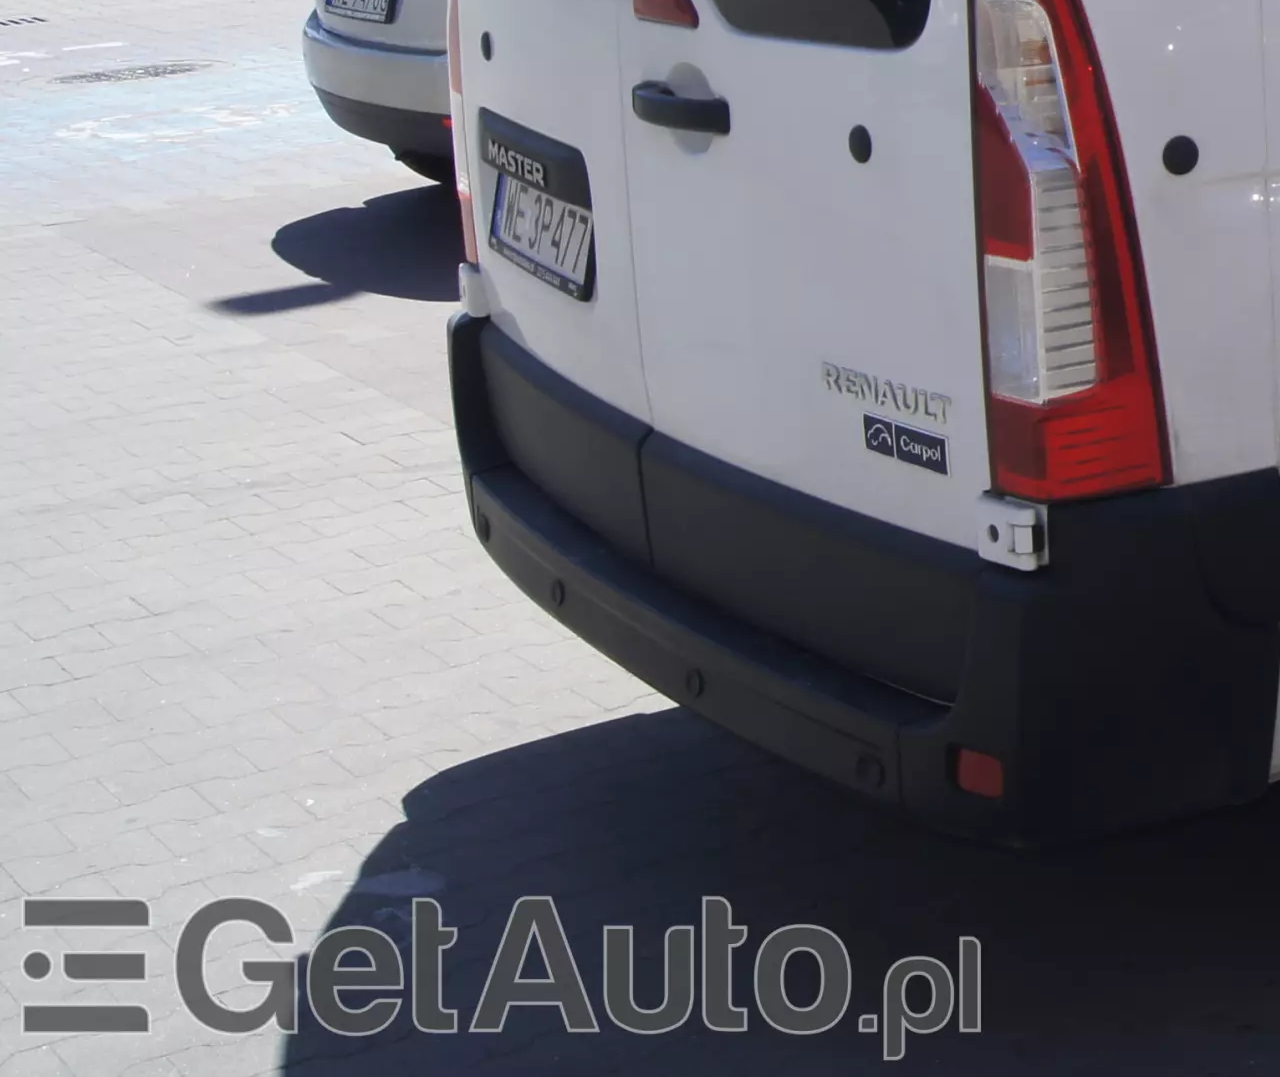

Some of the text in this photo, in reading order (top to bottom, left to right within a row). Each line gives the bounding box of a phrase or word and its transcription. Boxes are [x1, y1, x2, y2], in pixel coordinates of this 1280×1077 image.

[487, 138, 545, 187] MASTER
[503, 175, 529, 243] WE
[528, 193, 591, 274] 3P477
[821, 360, 952, 425] RENAULT
[900, 435, 941, 462] Carpol
